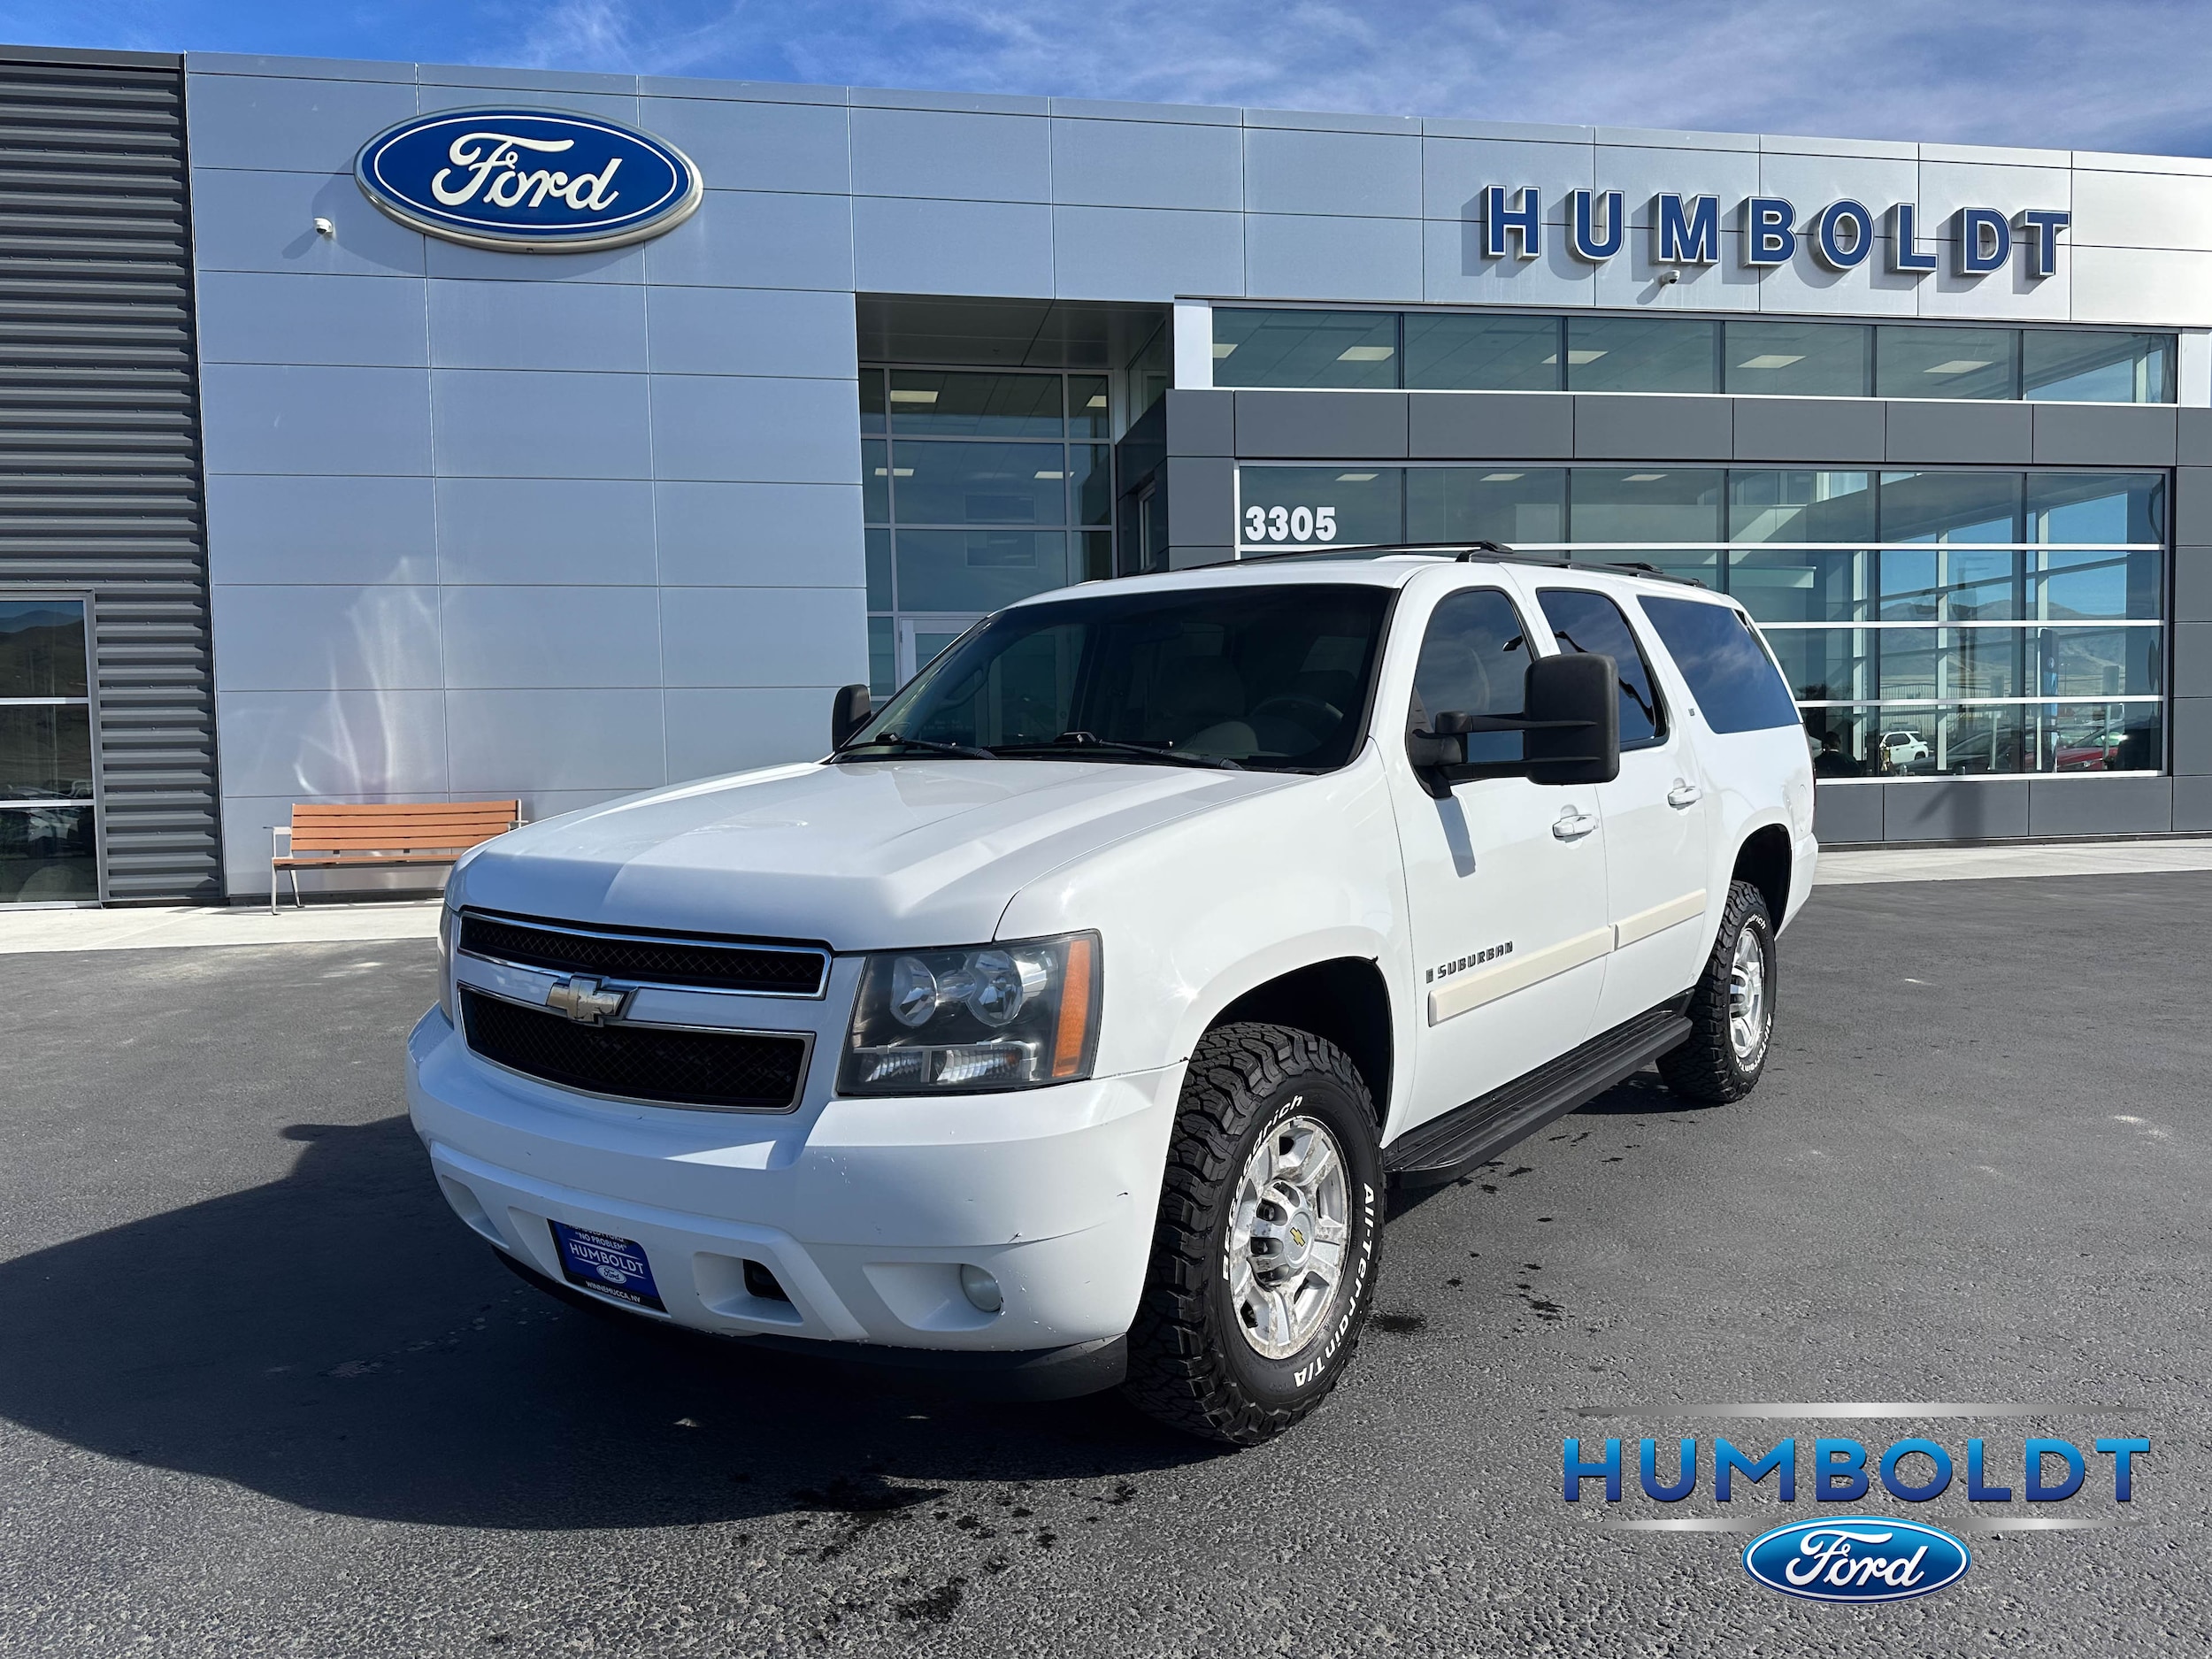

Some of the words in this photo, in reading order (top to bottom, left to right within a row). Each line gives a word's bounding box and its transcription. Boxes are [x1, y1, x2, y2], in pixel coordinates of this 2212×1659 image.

[432, 132, 623, 211] Ford
[1486, 184, 2070, 277] HUMBOLDT
[1245, 505, 1337, 541] 3305
[1437, 941, 1513, 979] SUBURBAN
[569, 1242, 644, 1274] HUMBOLDT
[1325, 1182, 1374, 1359] All-Terrain
[1294, 1356, 1325, 1387] T/A
